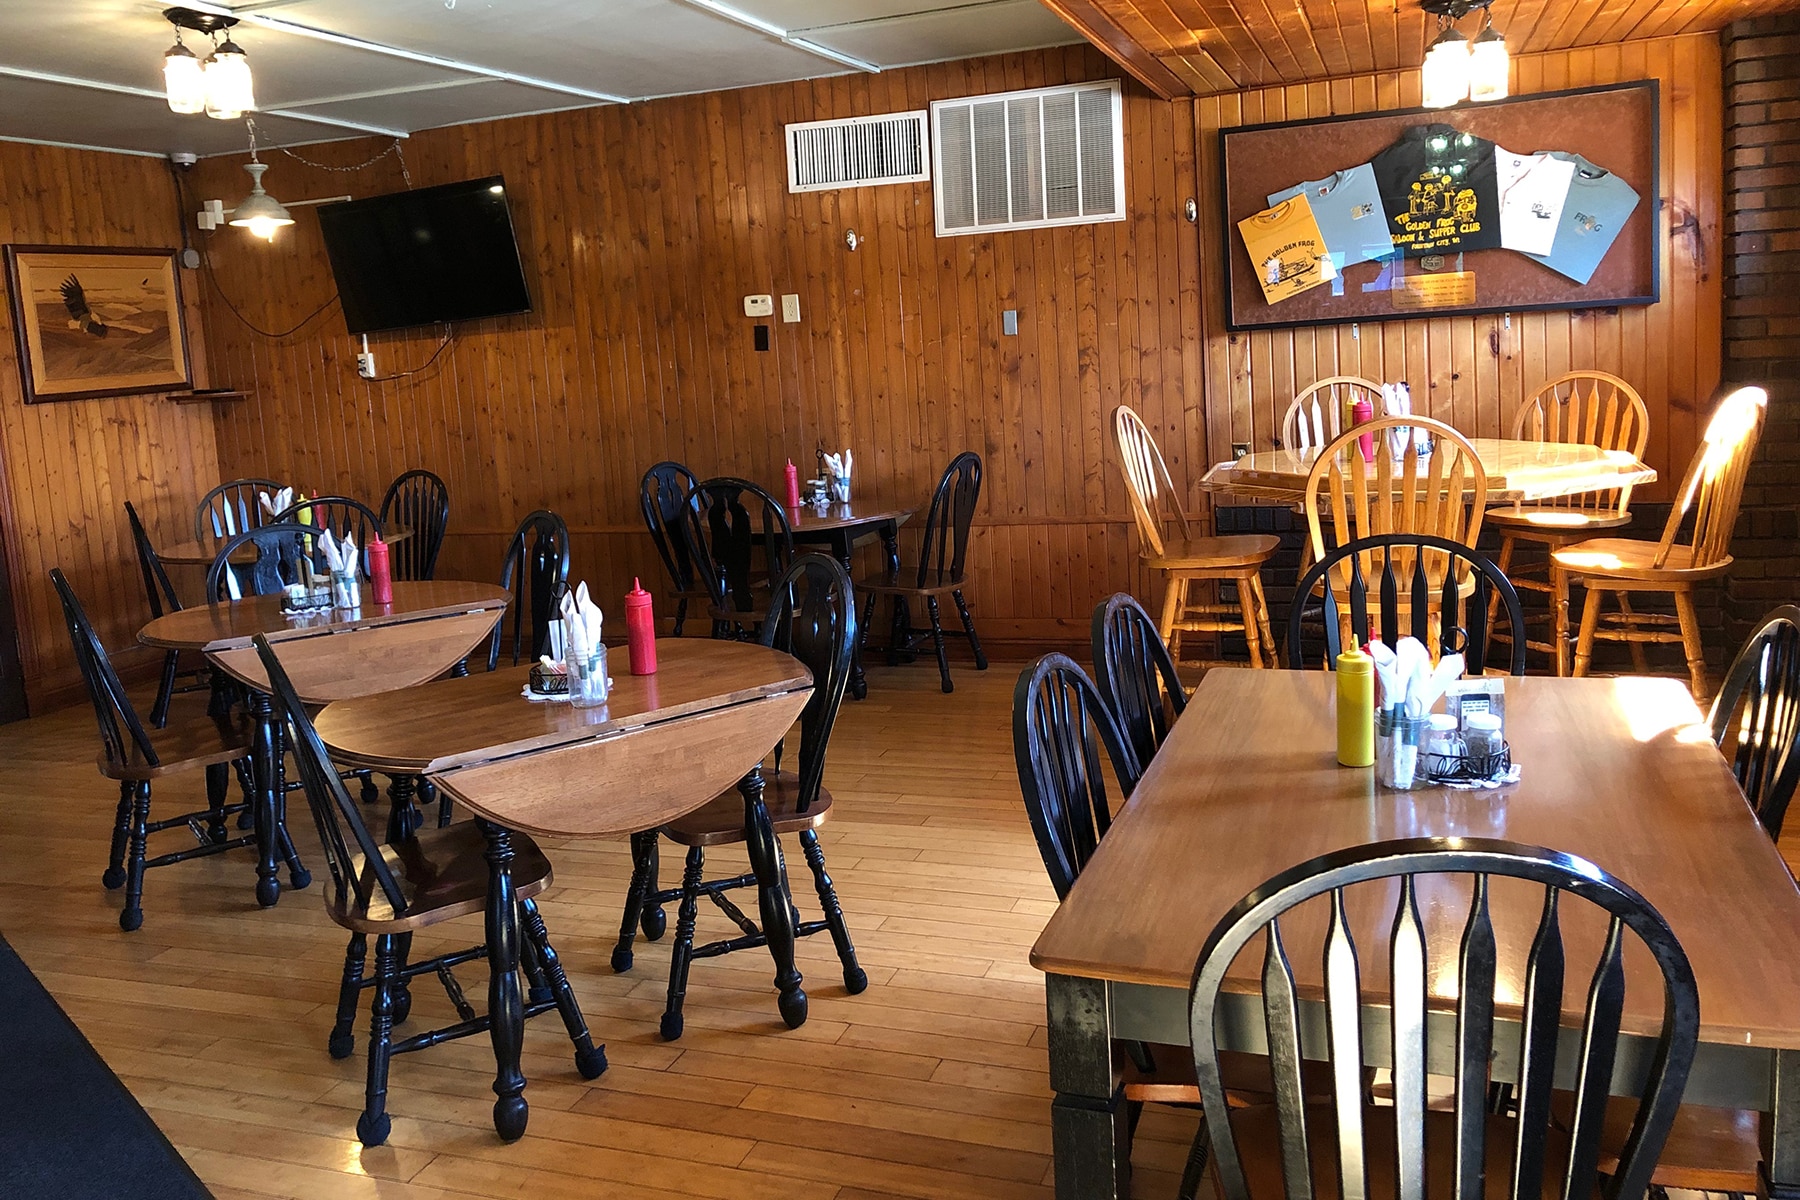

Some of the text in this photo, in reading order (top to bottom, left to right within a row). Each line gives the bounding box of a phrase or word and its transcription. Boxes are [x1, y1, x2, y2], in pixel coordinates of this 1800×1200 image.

[1395, 213, 1410, 224] THE
[1406, 217, 1454, 231] GOLDEN FROG
[1418, 231, 1425, 241] &
[1429, 227, 1455, 238] SUPPER
[1460, 222, 1481, 233] CLUB
[1261, 255, 1273, 268] THE
[1272, 242, 1298, 258] GOLDEN
